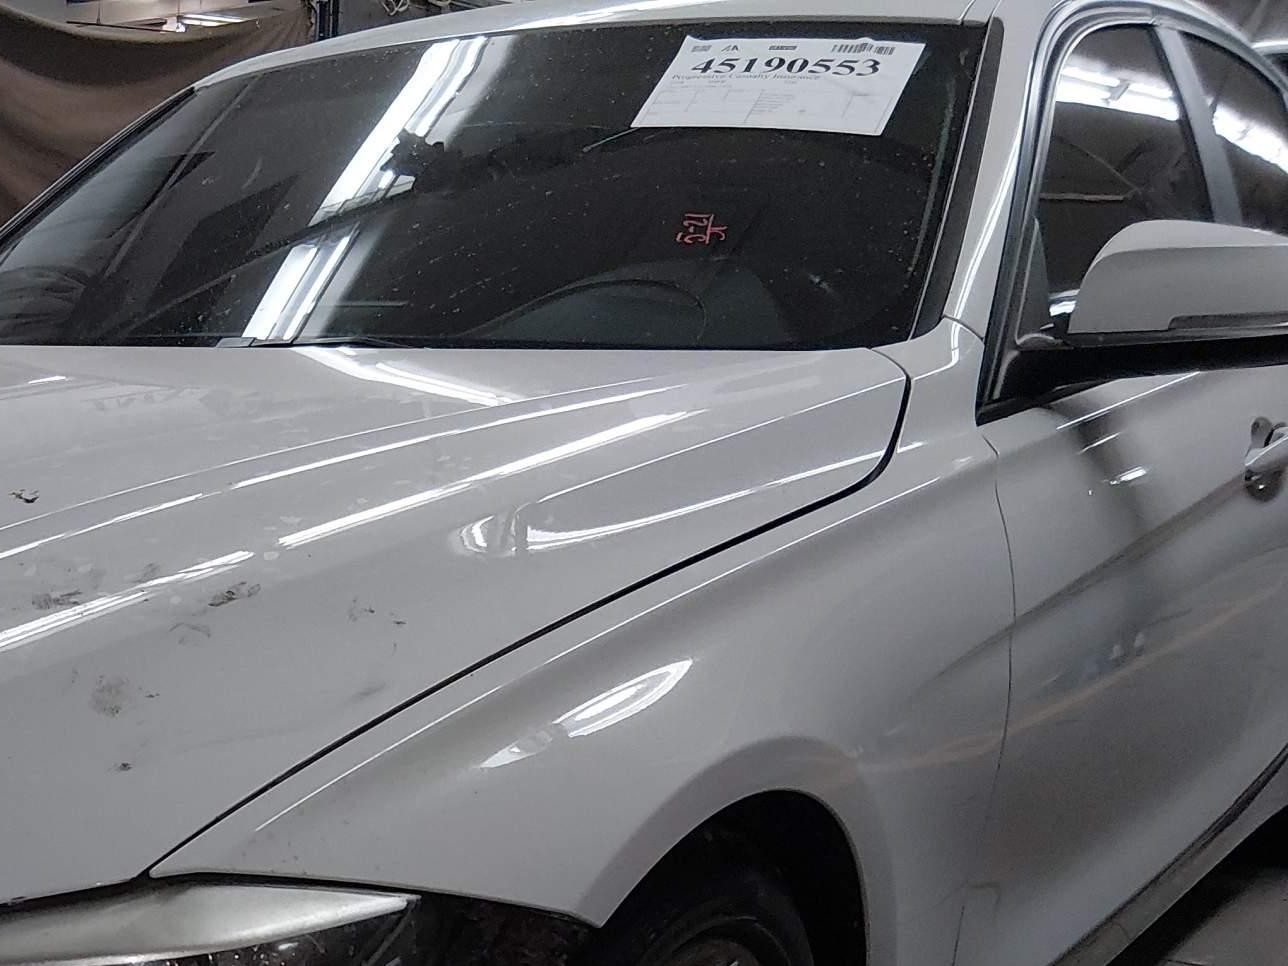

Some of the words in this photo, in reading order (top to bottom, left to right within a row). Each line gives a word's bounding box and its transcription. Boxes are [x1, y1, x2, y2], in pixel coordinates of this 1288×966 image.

[691, 56, 881, 77] 45190553
[671, 73, 727, 81] Progressive
[729, 73, 769, 81] Casualty
